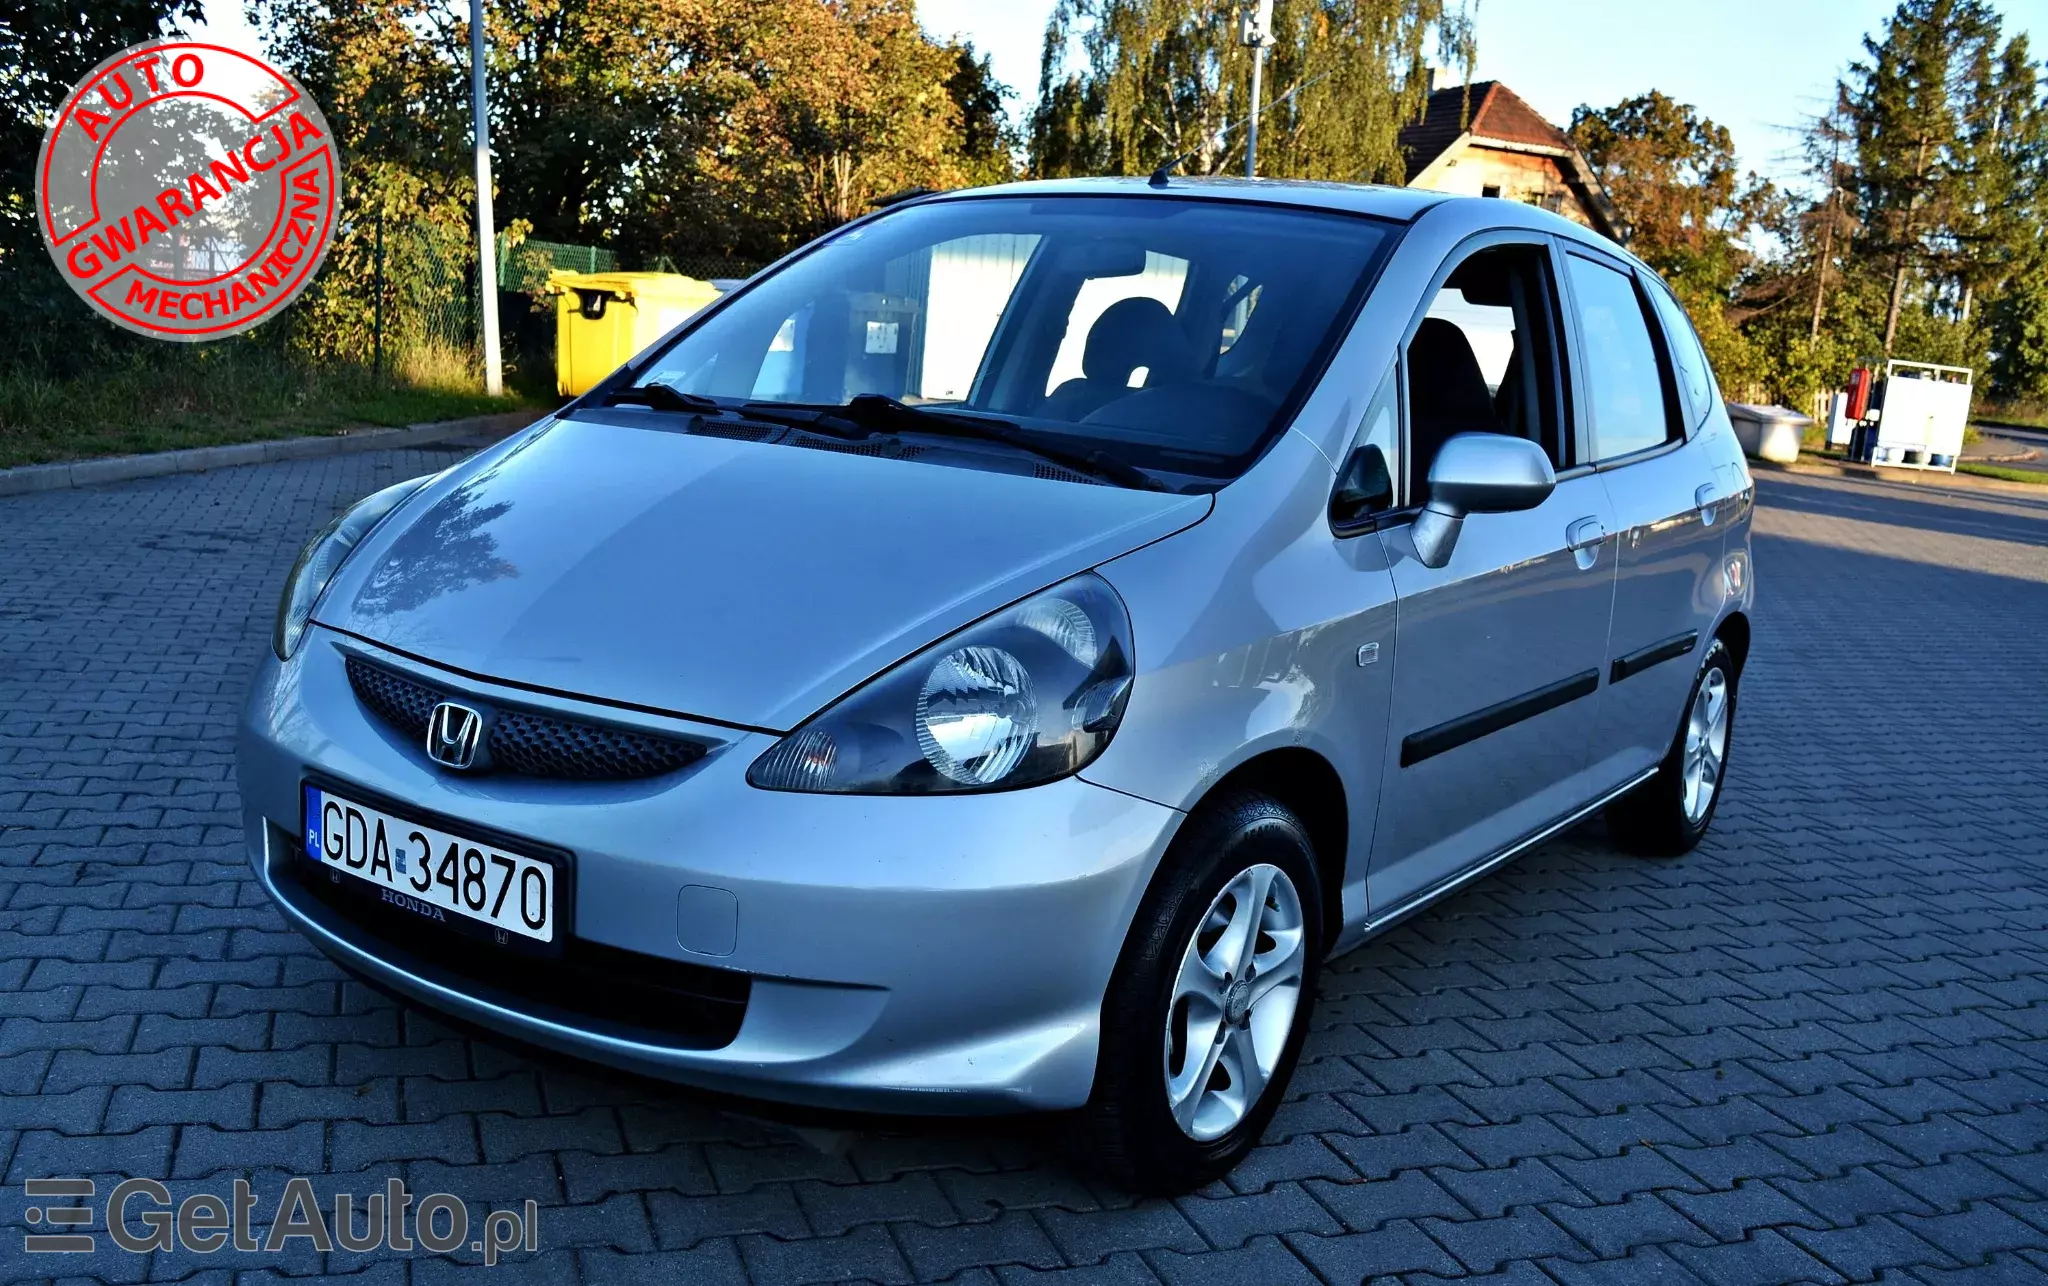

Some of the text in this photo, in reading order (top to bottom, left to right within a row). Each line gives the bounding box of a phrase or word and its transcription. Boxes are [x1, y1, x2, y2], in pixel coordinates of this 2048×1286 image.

[309, 829, 320, 848] PL
[323, 801, 546, 930] GDA 34870
[381, 888, 446, 922] HONDA
